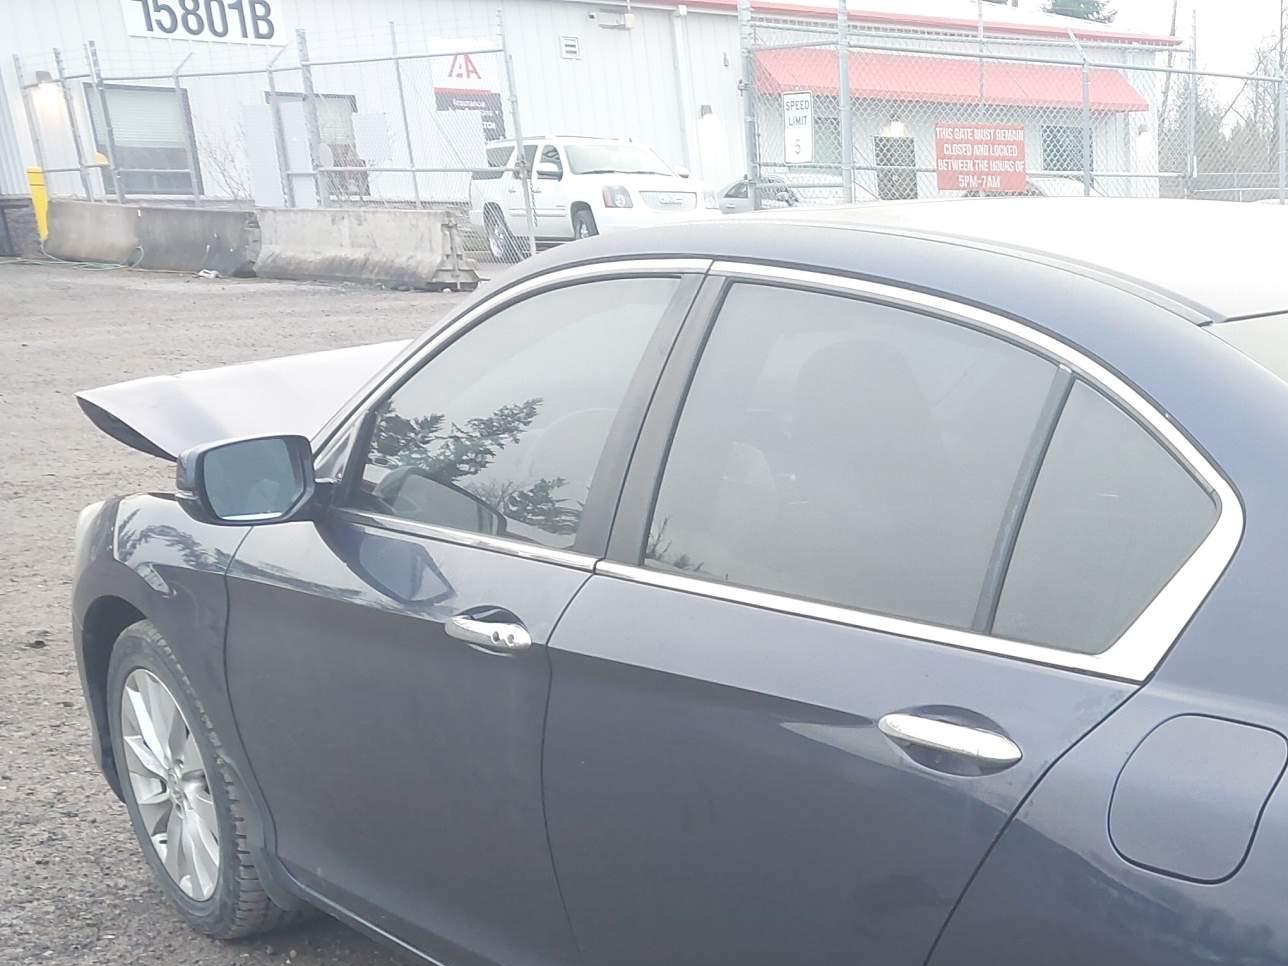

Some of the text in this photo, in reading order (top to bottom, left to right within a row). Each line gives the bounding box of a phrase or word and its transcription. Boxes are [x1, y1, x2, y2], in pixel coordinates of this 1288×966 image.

[131, 0, 275, 39] 15801B
[785, 100, 810, 111] SPEED
[788, 115, 808, 127] LIMIT
[936, 127, 1024, 141] THIS GATE MUST REMAIN
[943, 143, 1018, 156] CLOSED AND LOCKED
[938, 159, 1025, 172] BETWEEN THE HOURS OF
[959, 175, 1001, 188] 5PM-7AM
